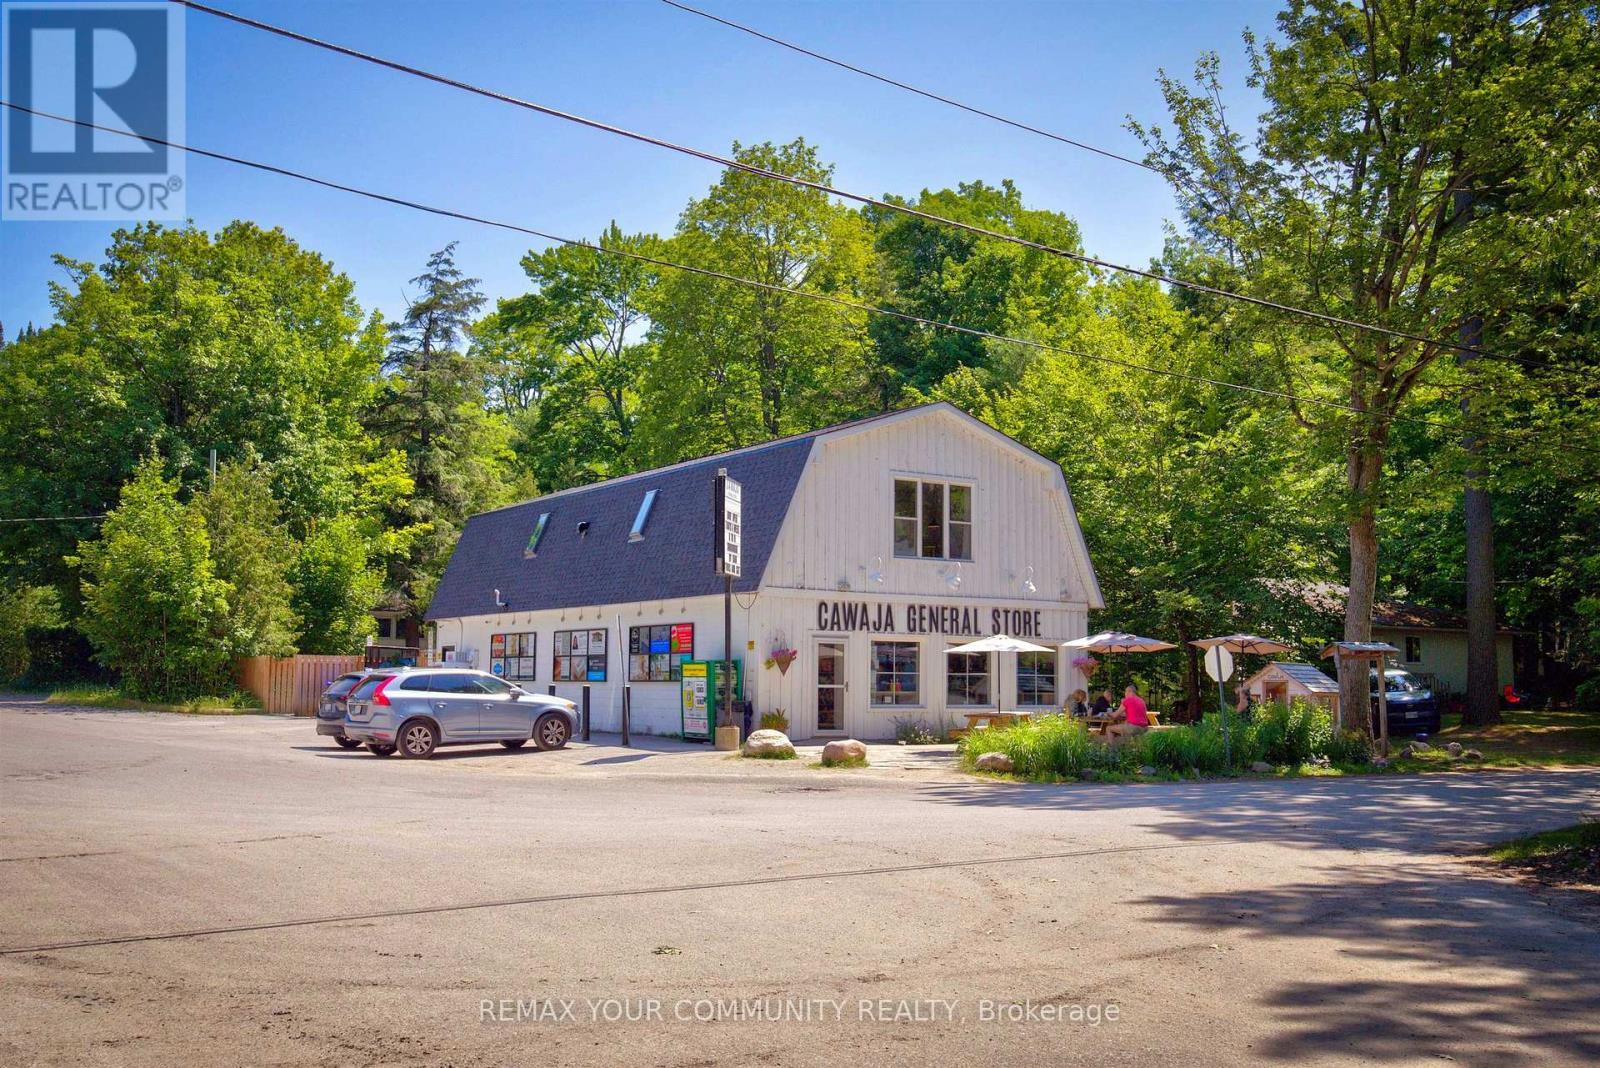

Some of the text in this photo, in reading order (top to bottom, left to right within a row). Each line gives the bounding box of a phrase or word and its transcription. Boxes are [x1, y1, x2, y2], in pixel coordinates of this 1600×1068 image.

[818, 602, 1042, 637] CAWAJA GENERAL STORE
